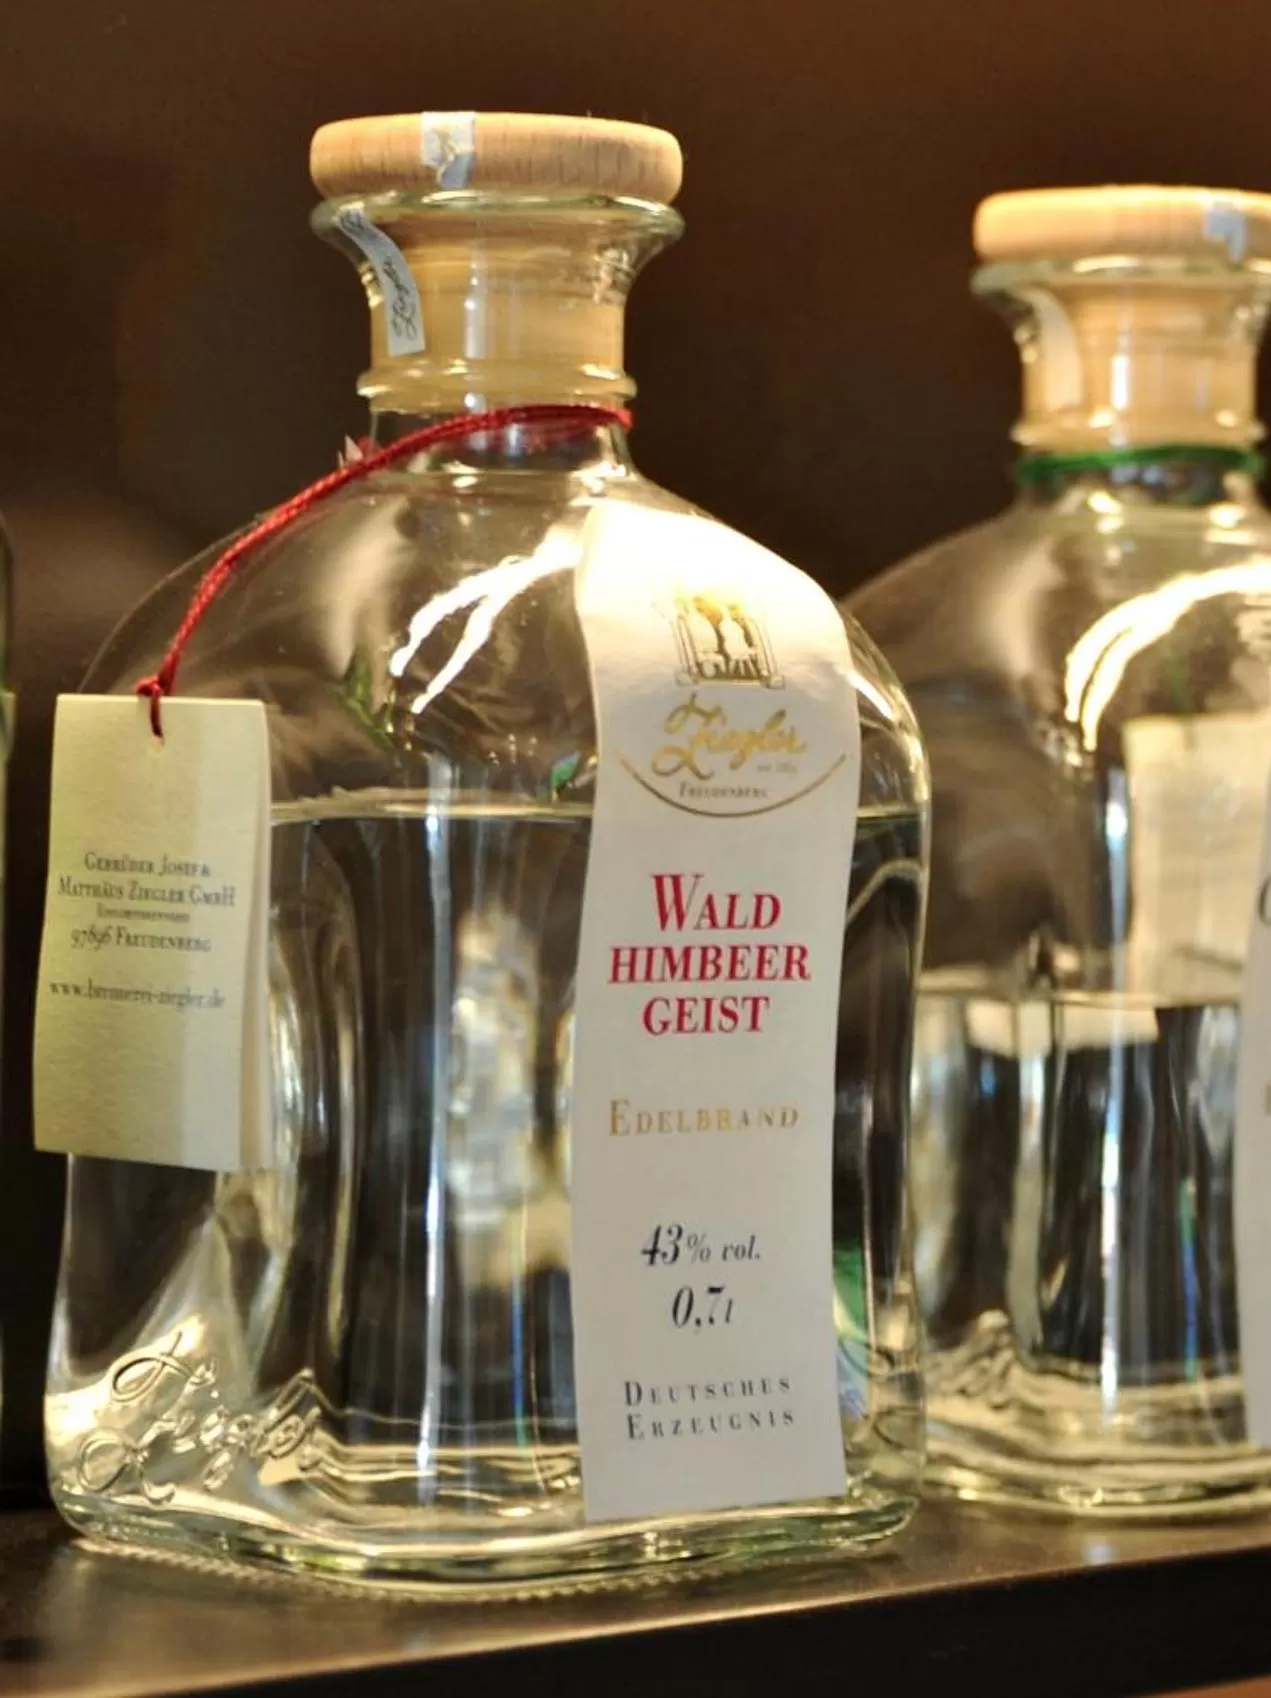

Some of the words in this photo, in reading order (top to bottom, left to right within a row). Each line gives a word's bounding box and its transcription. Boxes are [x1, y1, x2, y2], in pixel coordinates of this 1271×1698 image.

[650, 873, 782, 932] WALD
[608, 943, 812, 984] HIMBEER
[641, 995, 770, 1036] GEIST
[609, 1098, 800, 1138] EDELBRAND
[641, 1223, 712, 1266] 43%
[721, 1234, 762, 1263] vol.
[624, 1376, 792, 1407] DEUTSCHES
[626, 1409, 796, 1440] ERZEUGNIS
